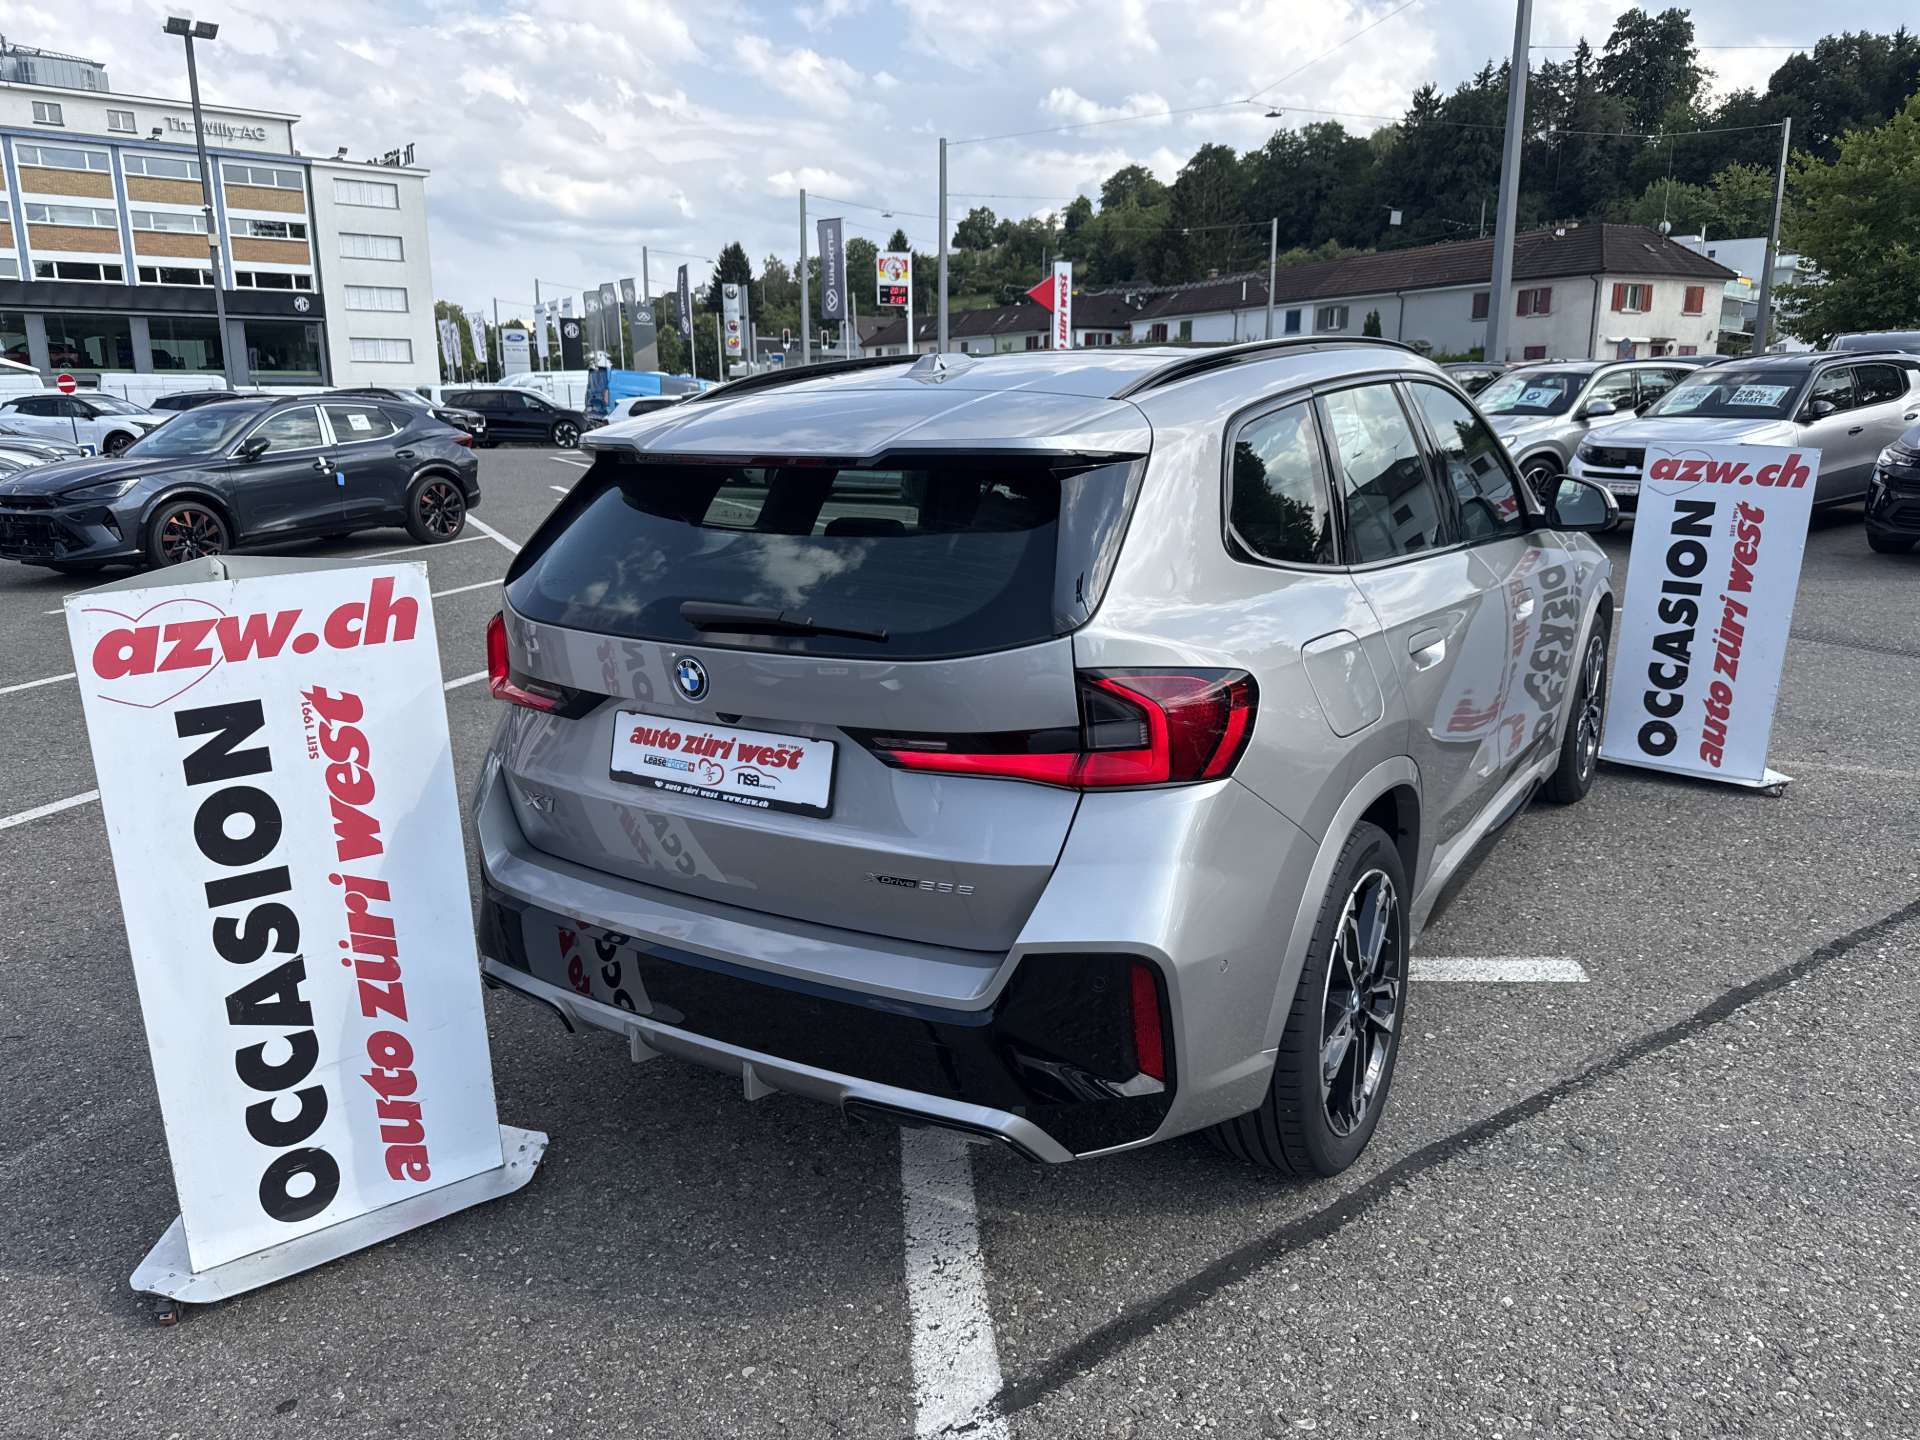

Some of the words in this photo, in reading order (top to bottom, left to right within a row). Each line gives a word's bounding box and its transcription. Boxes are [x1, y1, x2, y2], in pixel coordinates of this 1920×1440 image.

[242, 125, 266, 141] AG
[564, 322, 580, 339] MG
[1649, 454, 1810, 489] azw.ch
[1728, 500, 1765, 593] west
[92, 576, 419, 680] azw.ch
[1637, 499, 1716, 757] OCCASION
[1711, 594, 1748, 682] züri
[301, 701, 314, 730] 1991
[306, 735, 319, 760] SEIT
[629, 726, 681, 750] auto
[681, 733, 737, 760] züri
[737, 742, 804, 770] west
[1700, 680, 1733, 768] auto
[300, 685, 384, 862] west
[526, 791, 554, 813] X1
[664, 782, 682, 792] auto
[700, 788, 718, 799] west
[737, 772, 760, 788] nsa
[174, 699, 340, 1222] OCCASION
[328, 873, 408, 1023] züri
[360, 1030, 431, 1182] auto
